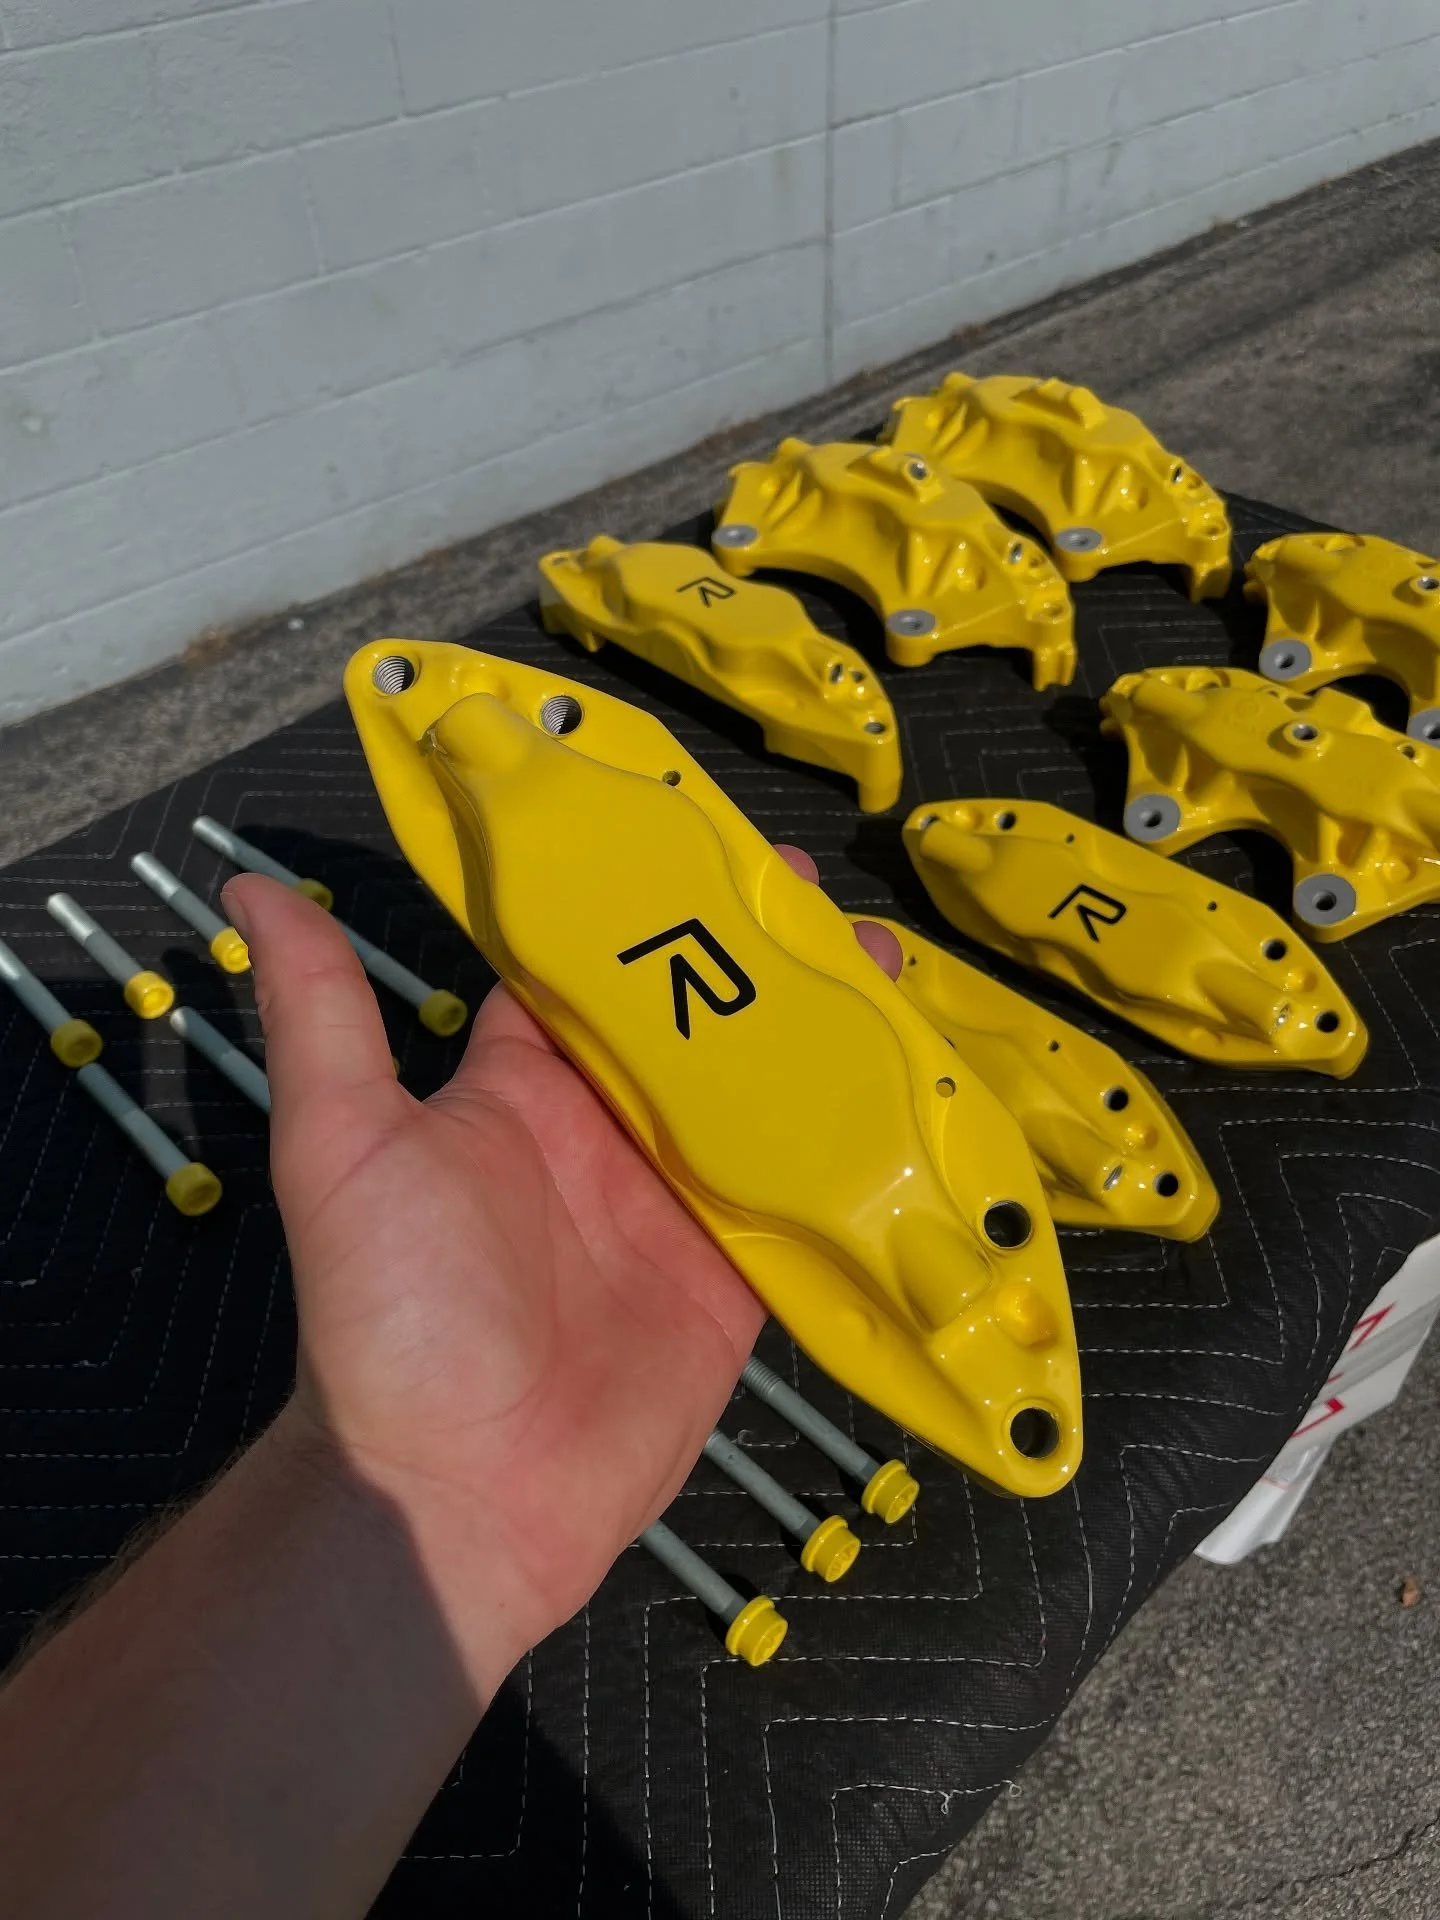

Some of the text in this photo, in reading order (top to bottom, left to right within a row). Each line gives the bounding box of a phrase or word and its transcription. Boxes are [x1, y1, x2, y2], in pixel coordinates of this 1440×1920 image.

[677, 577, 735, 608] R
[1048, 884, 1127, 942] R
[617, 919, 756, 1040] R
